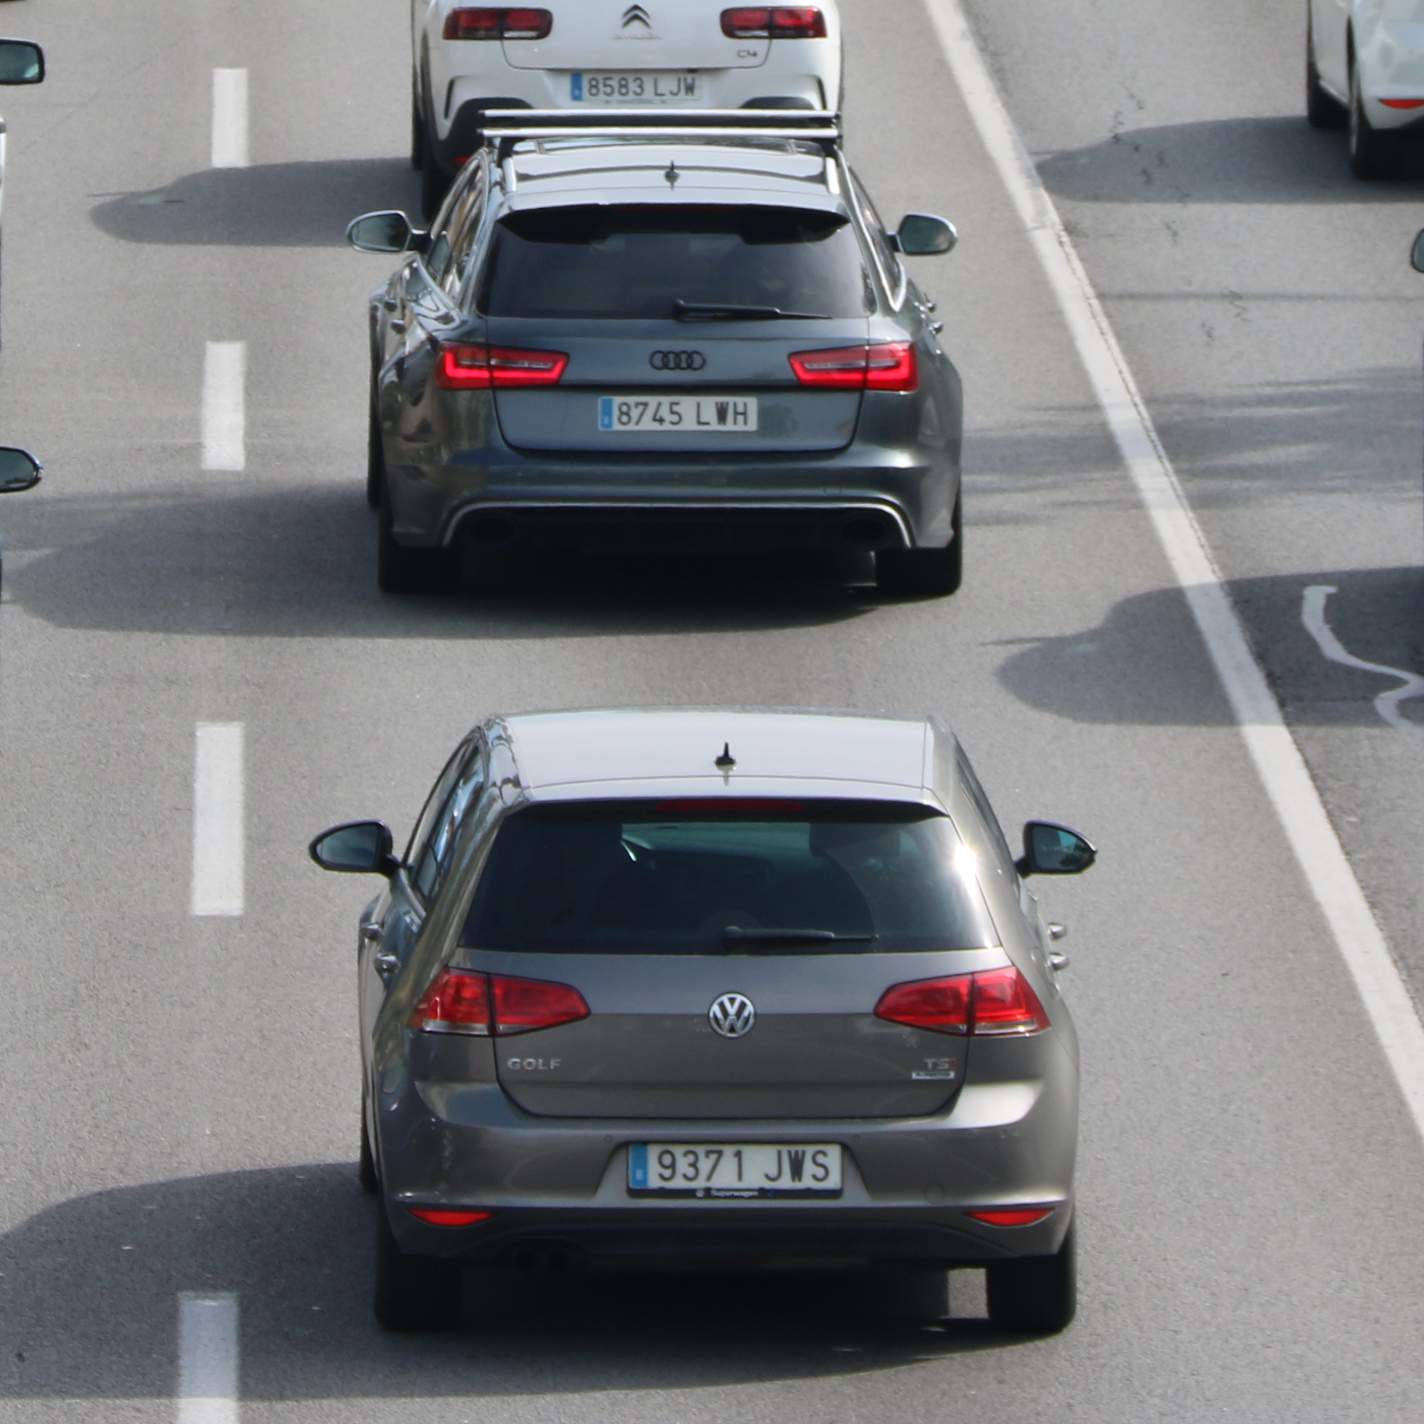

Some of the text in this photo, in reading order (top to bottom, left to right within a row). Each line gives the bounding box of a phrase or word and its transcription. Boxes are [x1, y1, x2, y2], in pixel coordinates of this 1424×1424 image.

[587, 76, 696, 97] 8583 LJW
[617, 400, 749, 427] 8745 LWH
[506, 1057, 563, 1071] GOLF
[656, 1148, 831, 1183] 9371 JWS
